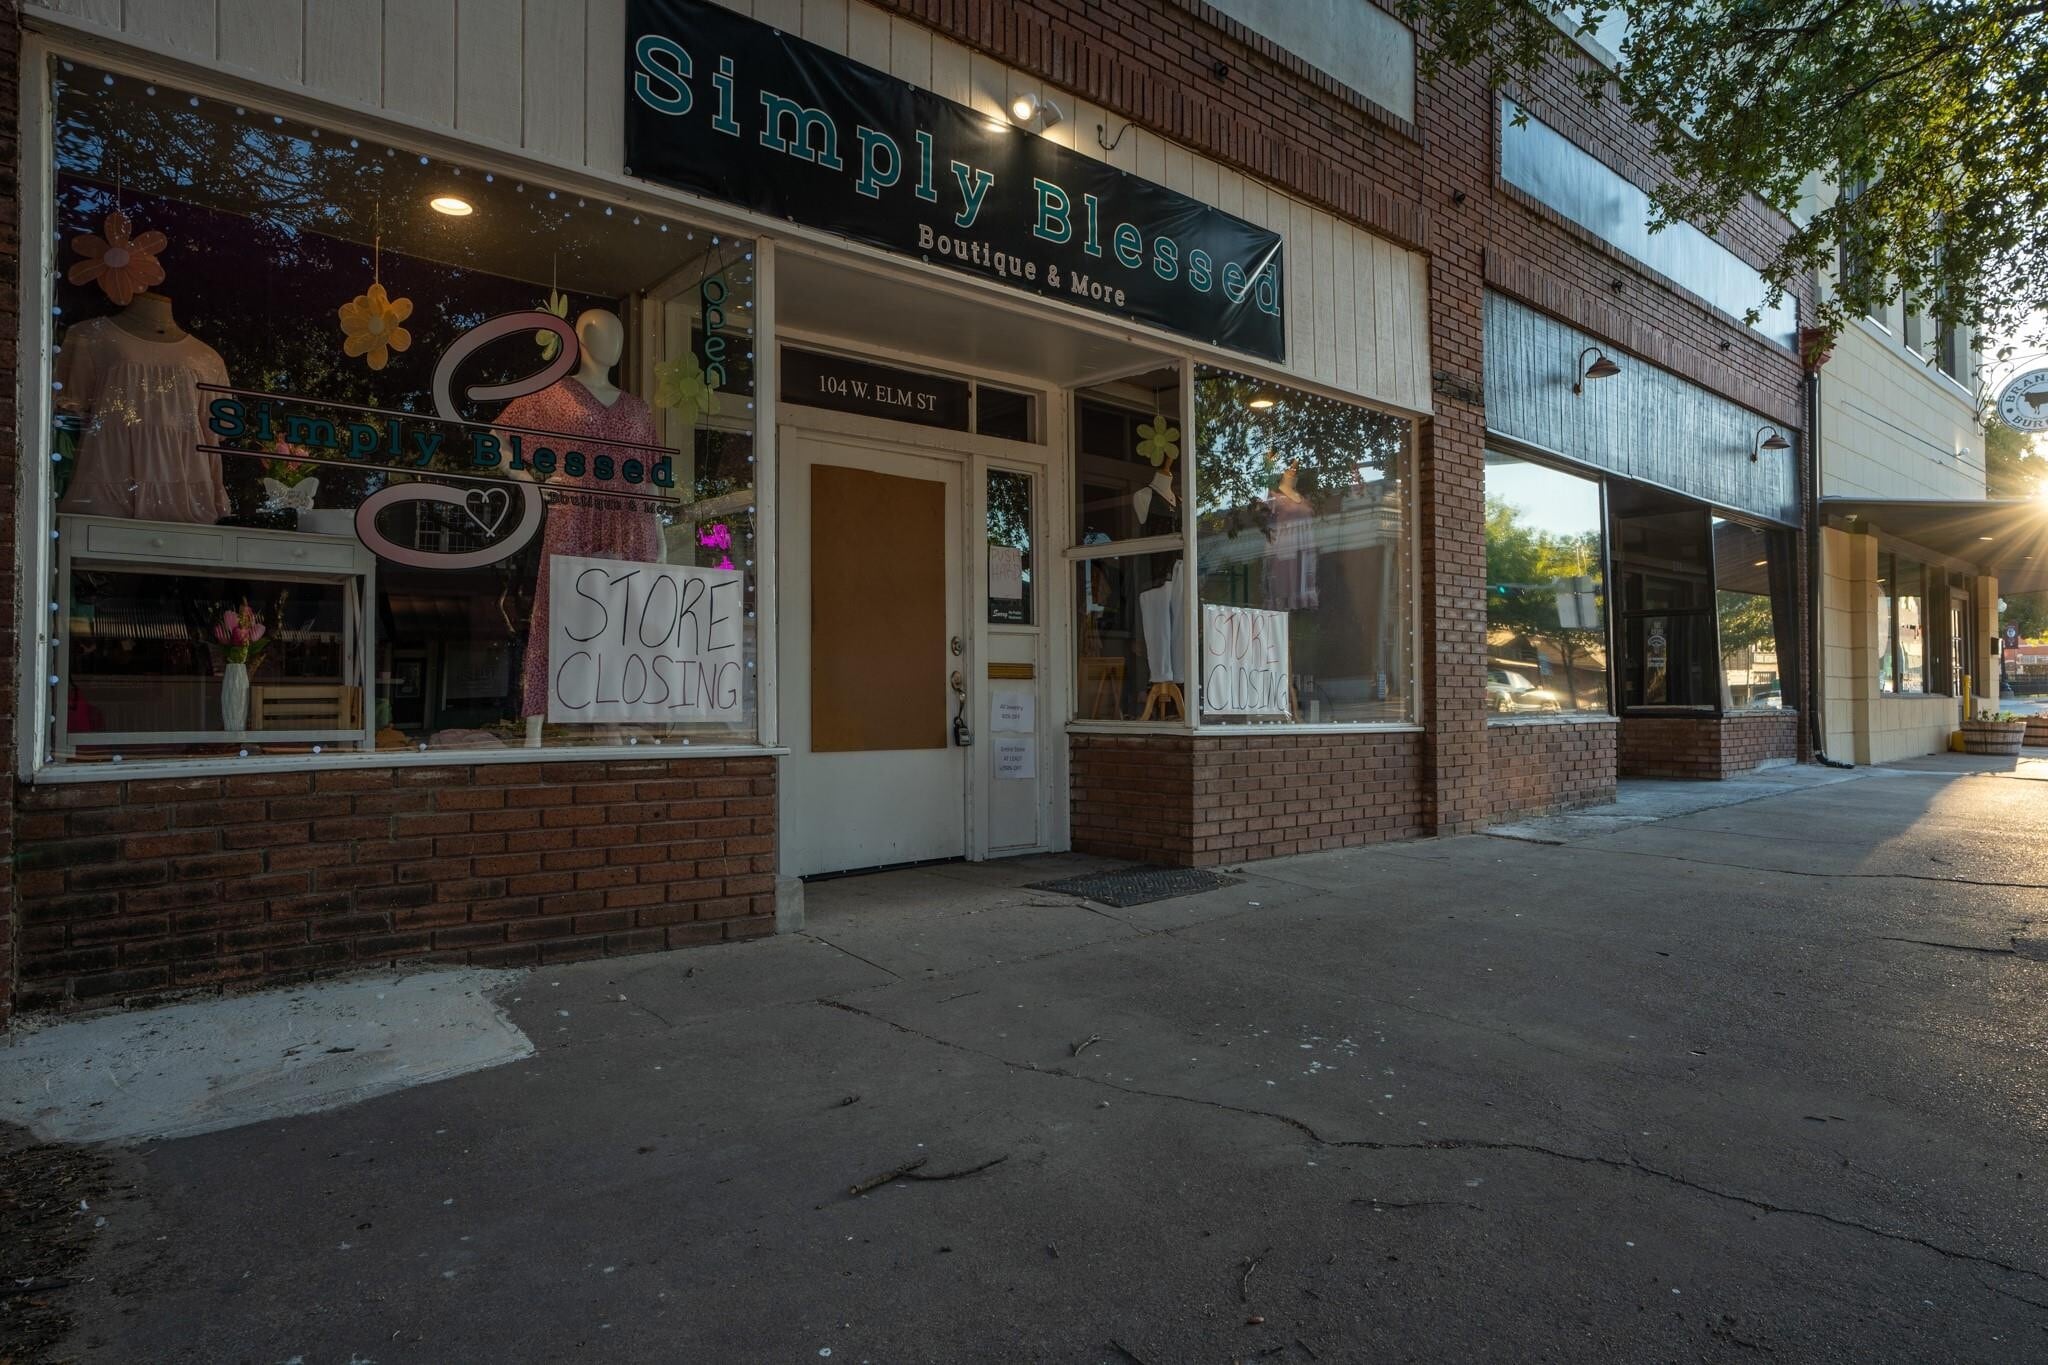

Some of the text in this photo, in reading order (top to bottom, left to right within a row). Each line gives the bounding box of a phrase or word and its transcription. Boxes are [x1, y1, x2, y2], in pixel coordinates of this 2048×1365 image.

[633, 34, 1281, 317] Simply Blessed
[918, 223, 1126, 307] Boutique & More
[820, 375, 937, 411] 104 W. ELM ST
[2005, 373, 2048, 403] BRAN
[208, 398, 675, 489] Simply Blessed
[2013, 415, 2048, 428] BUR
[565, 568, 739, 656] STORE
[1209, 611, 1281, 665] STORE
[556, 651, 741, 710] CLOSING
[1206, 664, 1288, 712] CLOSING
